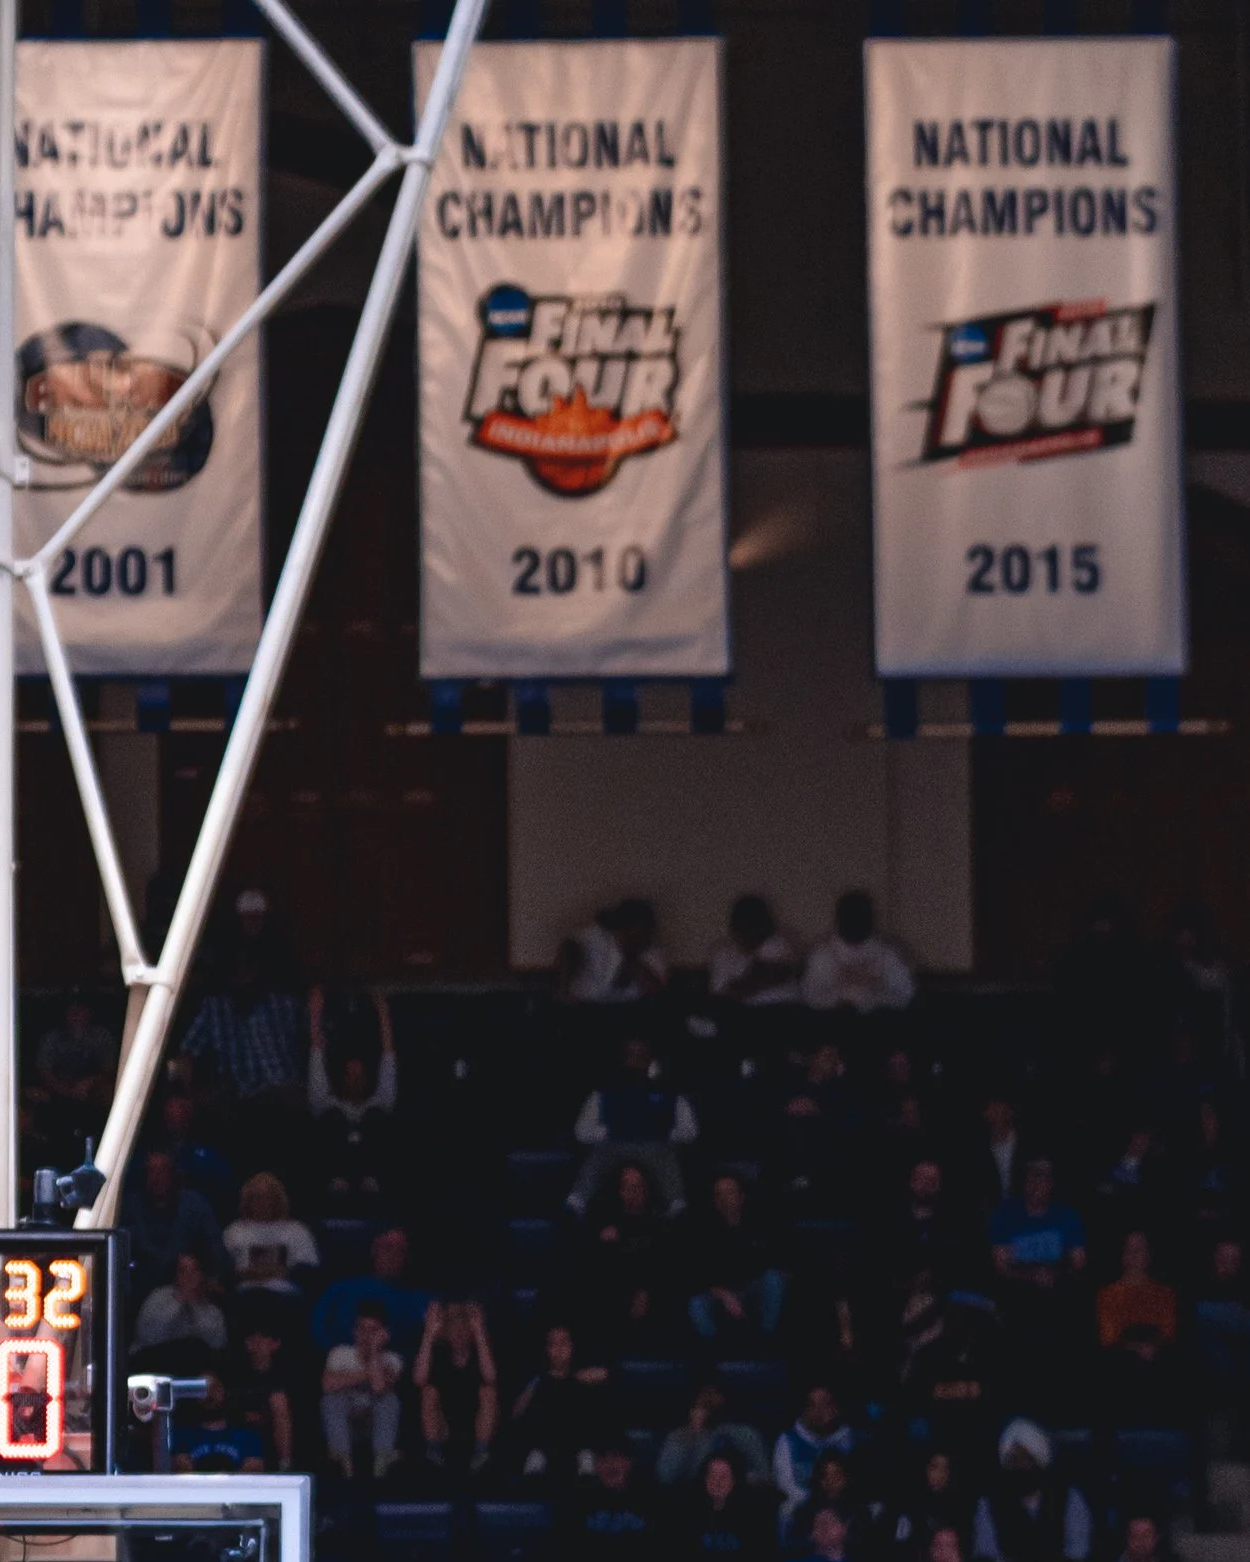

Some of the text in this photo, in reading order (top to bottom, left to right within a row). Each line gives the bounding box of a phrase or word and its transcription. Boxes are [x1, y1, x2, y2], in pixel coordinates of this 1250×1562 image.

[913, 117, 1128, 167] NATIONAL
[890, 186, 1157, 238] CHAMPIONS
[51, 547, 174, 596] 2001
[513, 546, 646, 595] 2010
[966, 543, 1101, 593] 2015
